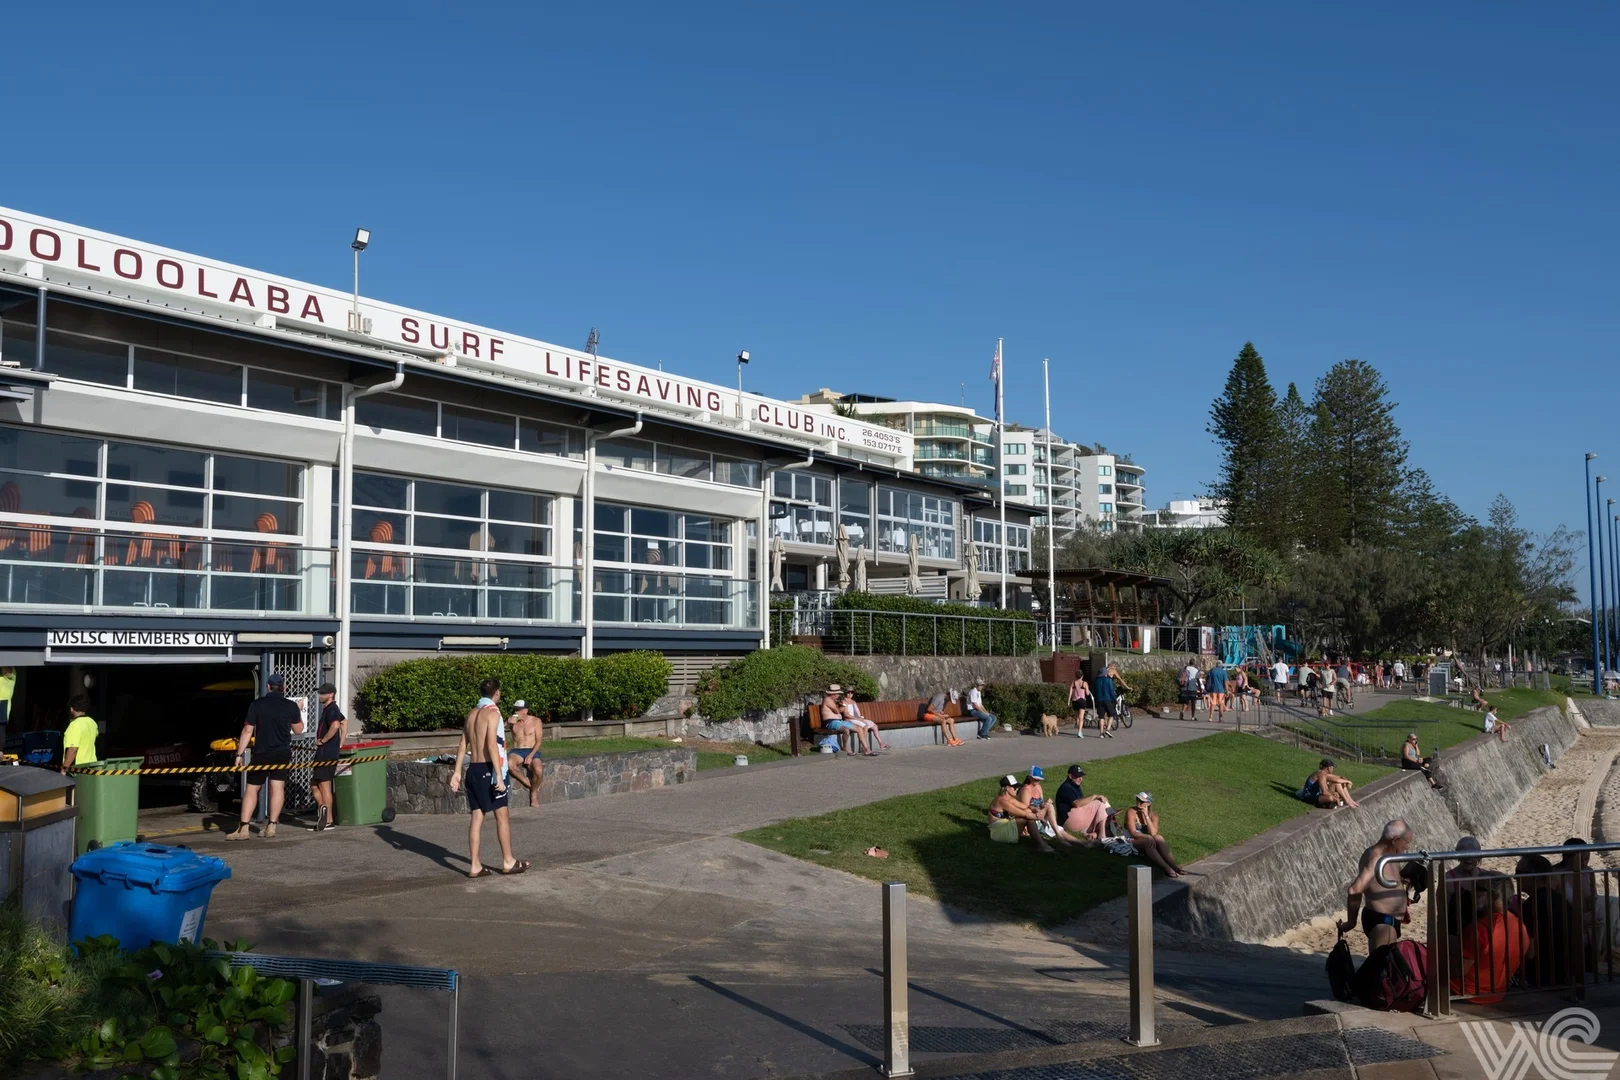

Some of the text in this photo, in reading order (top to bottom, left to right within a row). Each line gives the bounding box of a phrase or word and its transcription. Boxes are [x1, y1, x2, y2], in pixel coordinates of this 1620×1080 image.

[401, 317, 504, 361] SURF
[545, 352, 721, 412] LIFESAVING
[758, 404, 814, 433] CLUB
[821, 423, 850, 442] INC.
[52, 630, 231, 645] MSLSC MEMBERS ONLY
